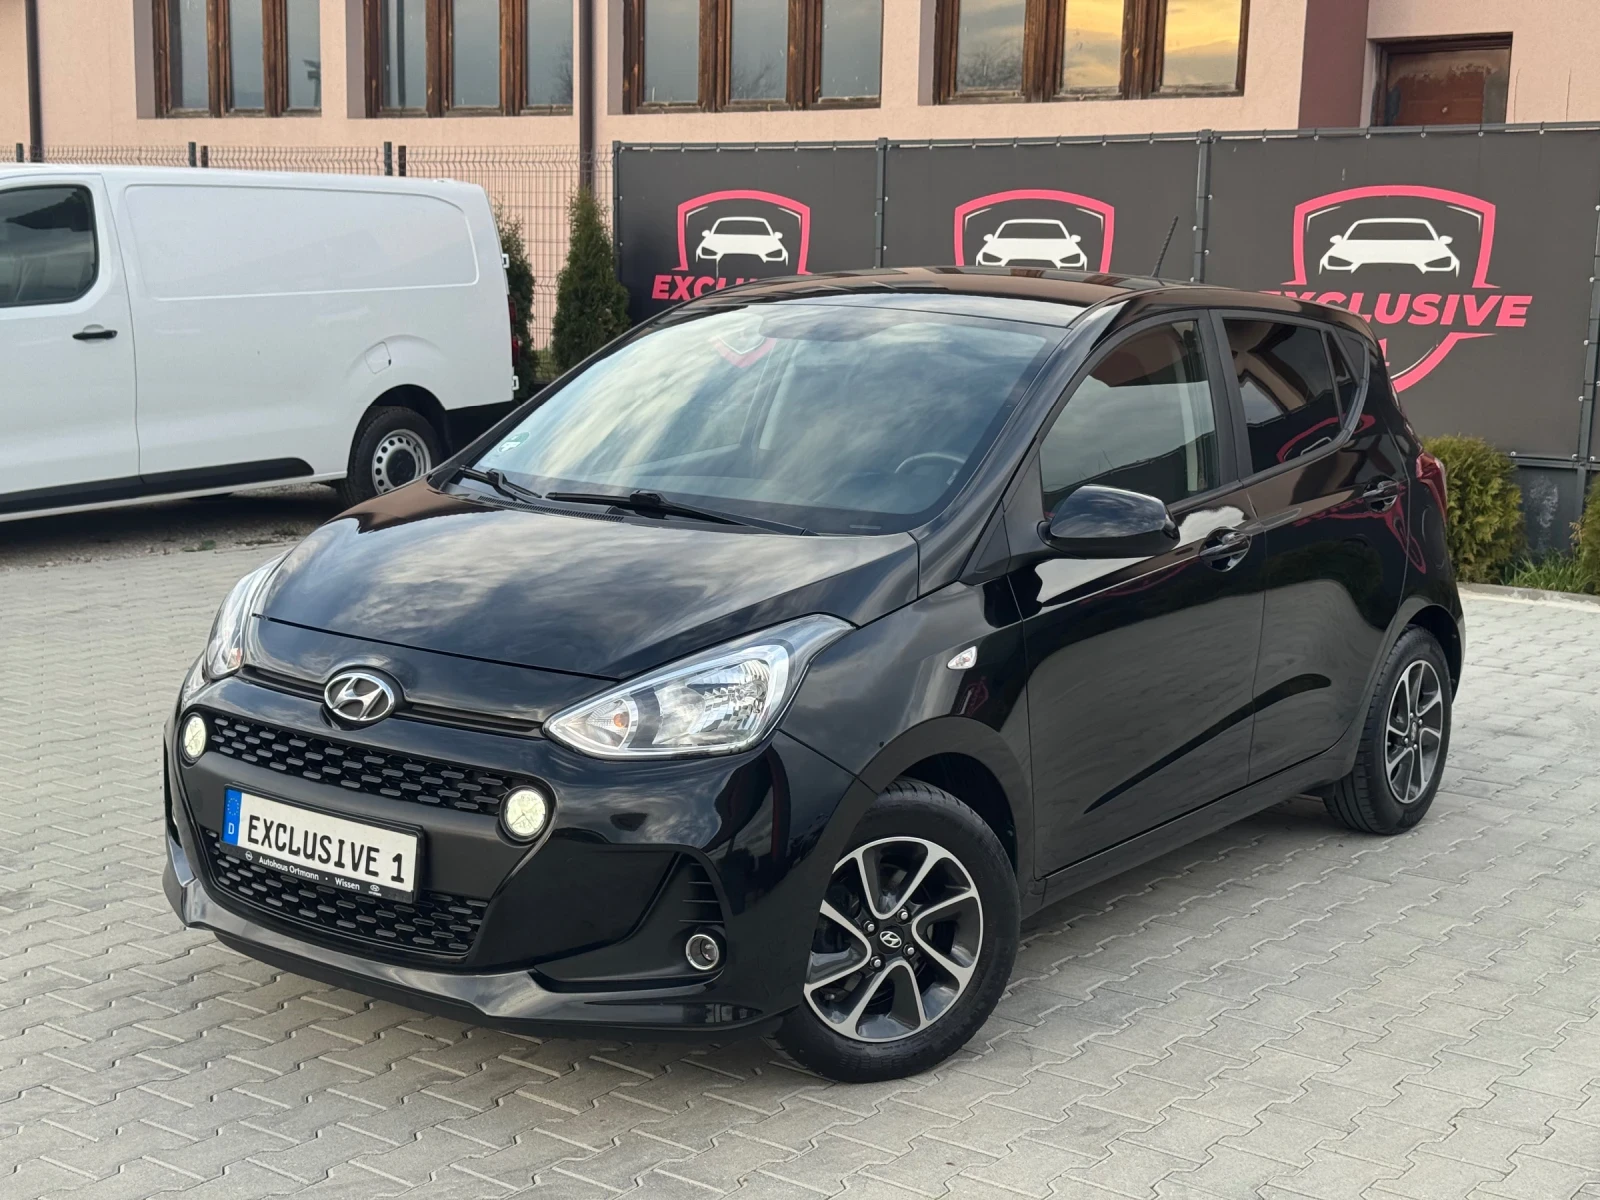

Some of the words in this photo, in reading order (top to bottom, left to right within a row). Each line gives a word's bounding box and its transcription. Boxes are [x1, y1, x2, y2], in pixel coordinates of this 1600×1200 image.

[228, 821, 235, 835] D
[247, 814, 380, 878] EXCLUSIVE
[391, 853, 405, 884] 1
[258, 855, 288, 872] Autohaus
[289, 865, 320, 881] Ortmann
[334, 876, 361, 891] Wissen
